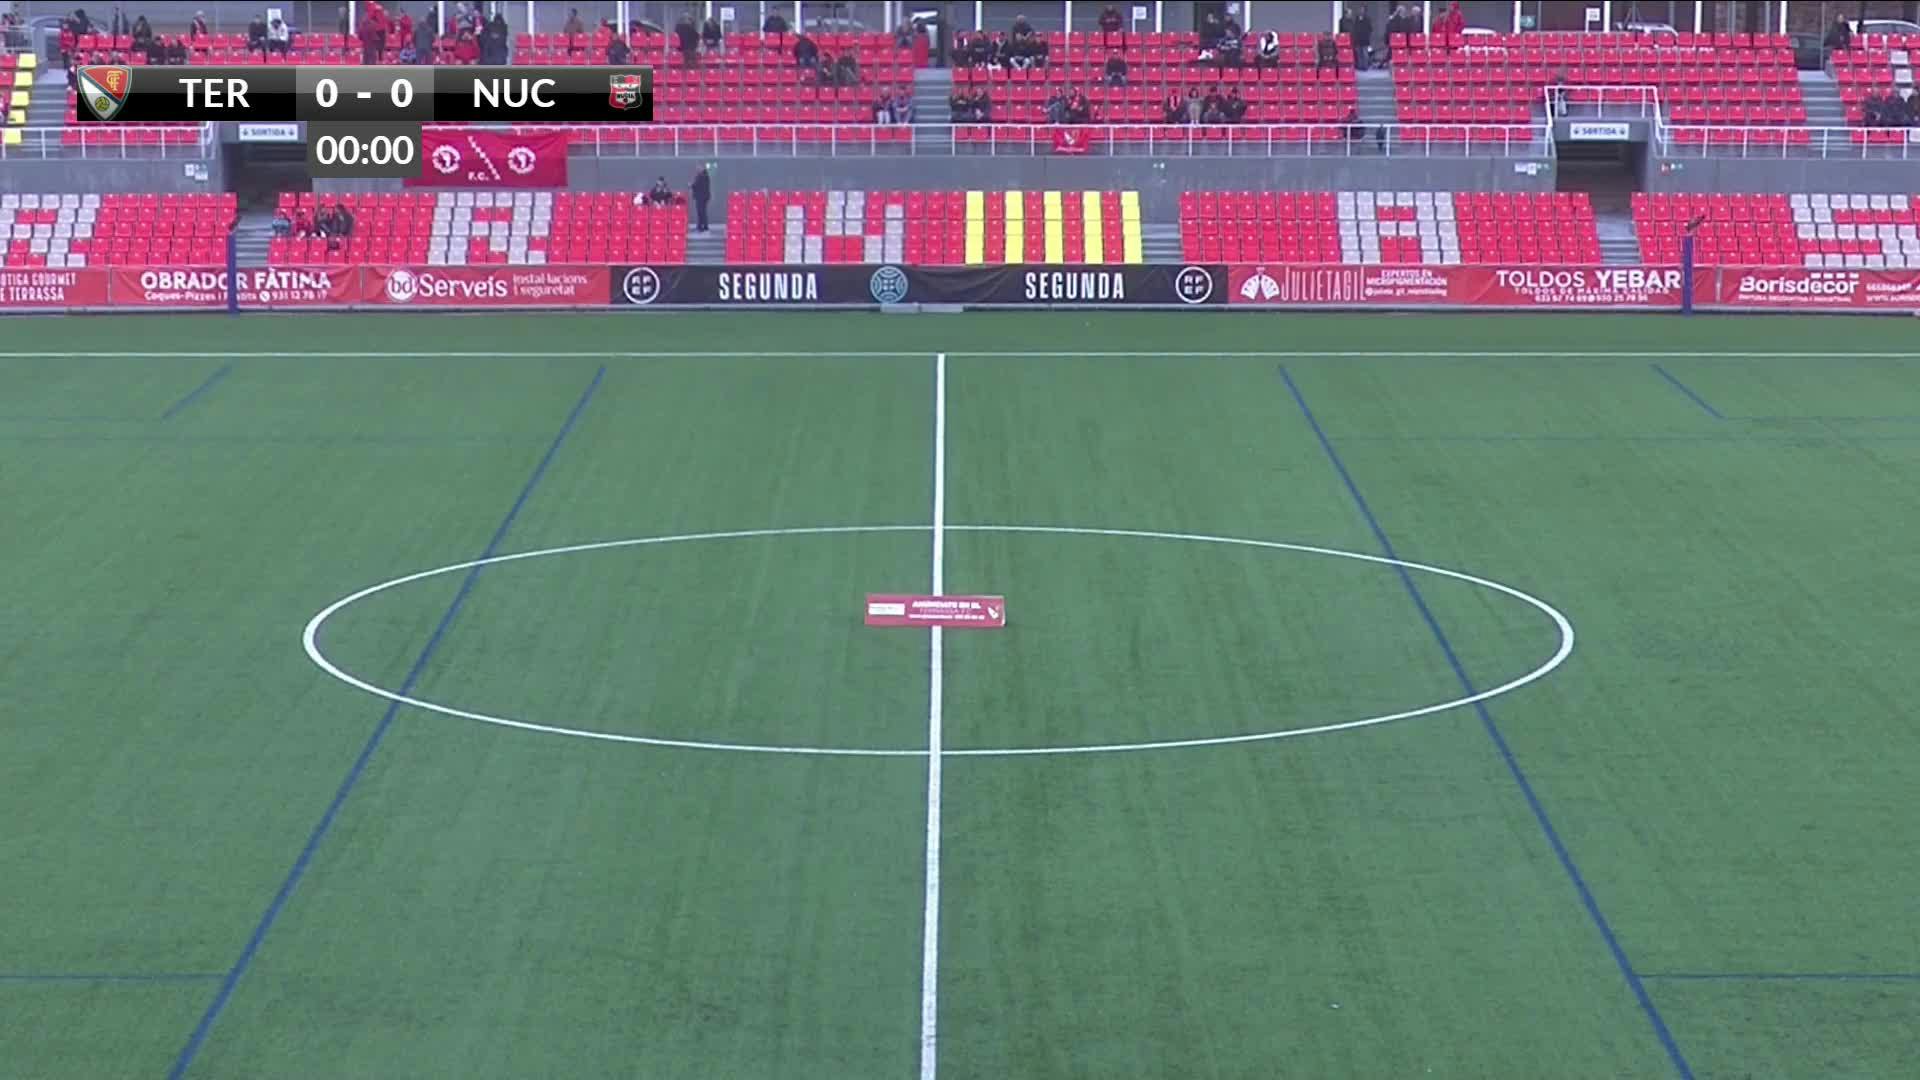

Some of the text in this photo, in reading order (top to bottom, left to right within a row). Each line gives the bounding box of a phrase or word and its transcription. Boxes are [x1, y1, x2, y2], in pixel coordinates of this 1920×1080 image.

[468, 171, 490, 181] F.C.
[31, 272, 77, 286] GOURMET
[419, 273, 508, 298] Serveis
[719, 272, 818, 301] SEGUNDA
[1025, 271, 1125, 300] SEGUNDA
[1496, 269, 1682, 288] TOLDOS YEBAR
[1739, 275, 1860, 294] Borisdecor
[9, 287, 65, 301] TERRASSA
[1514, 287, 1556, 295] TOLDOS
